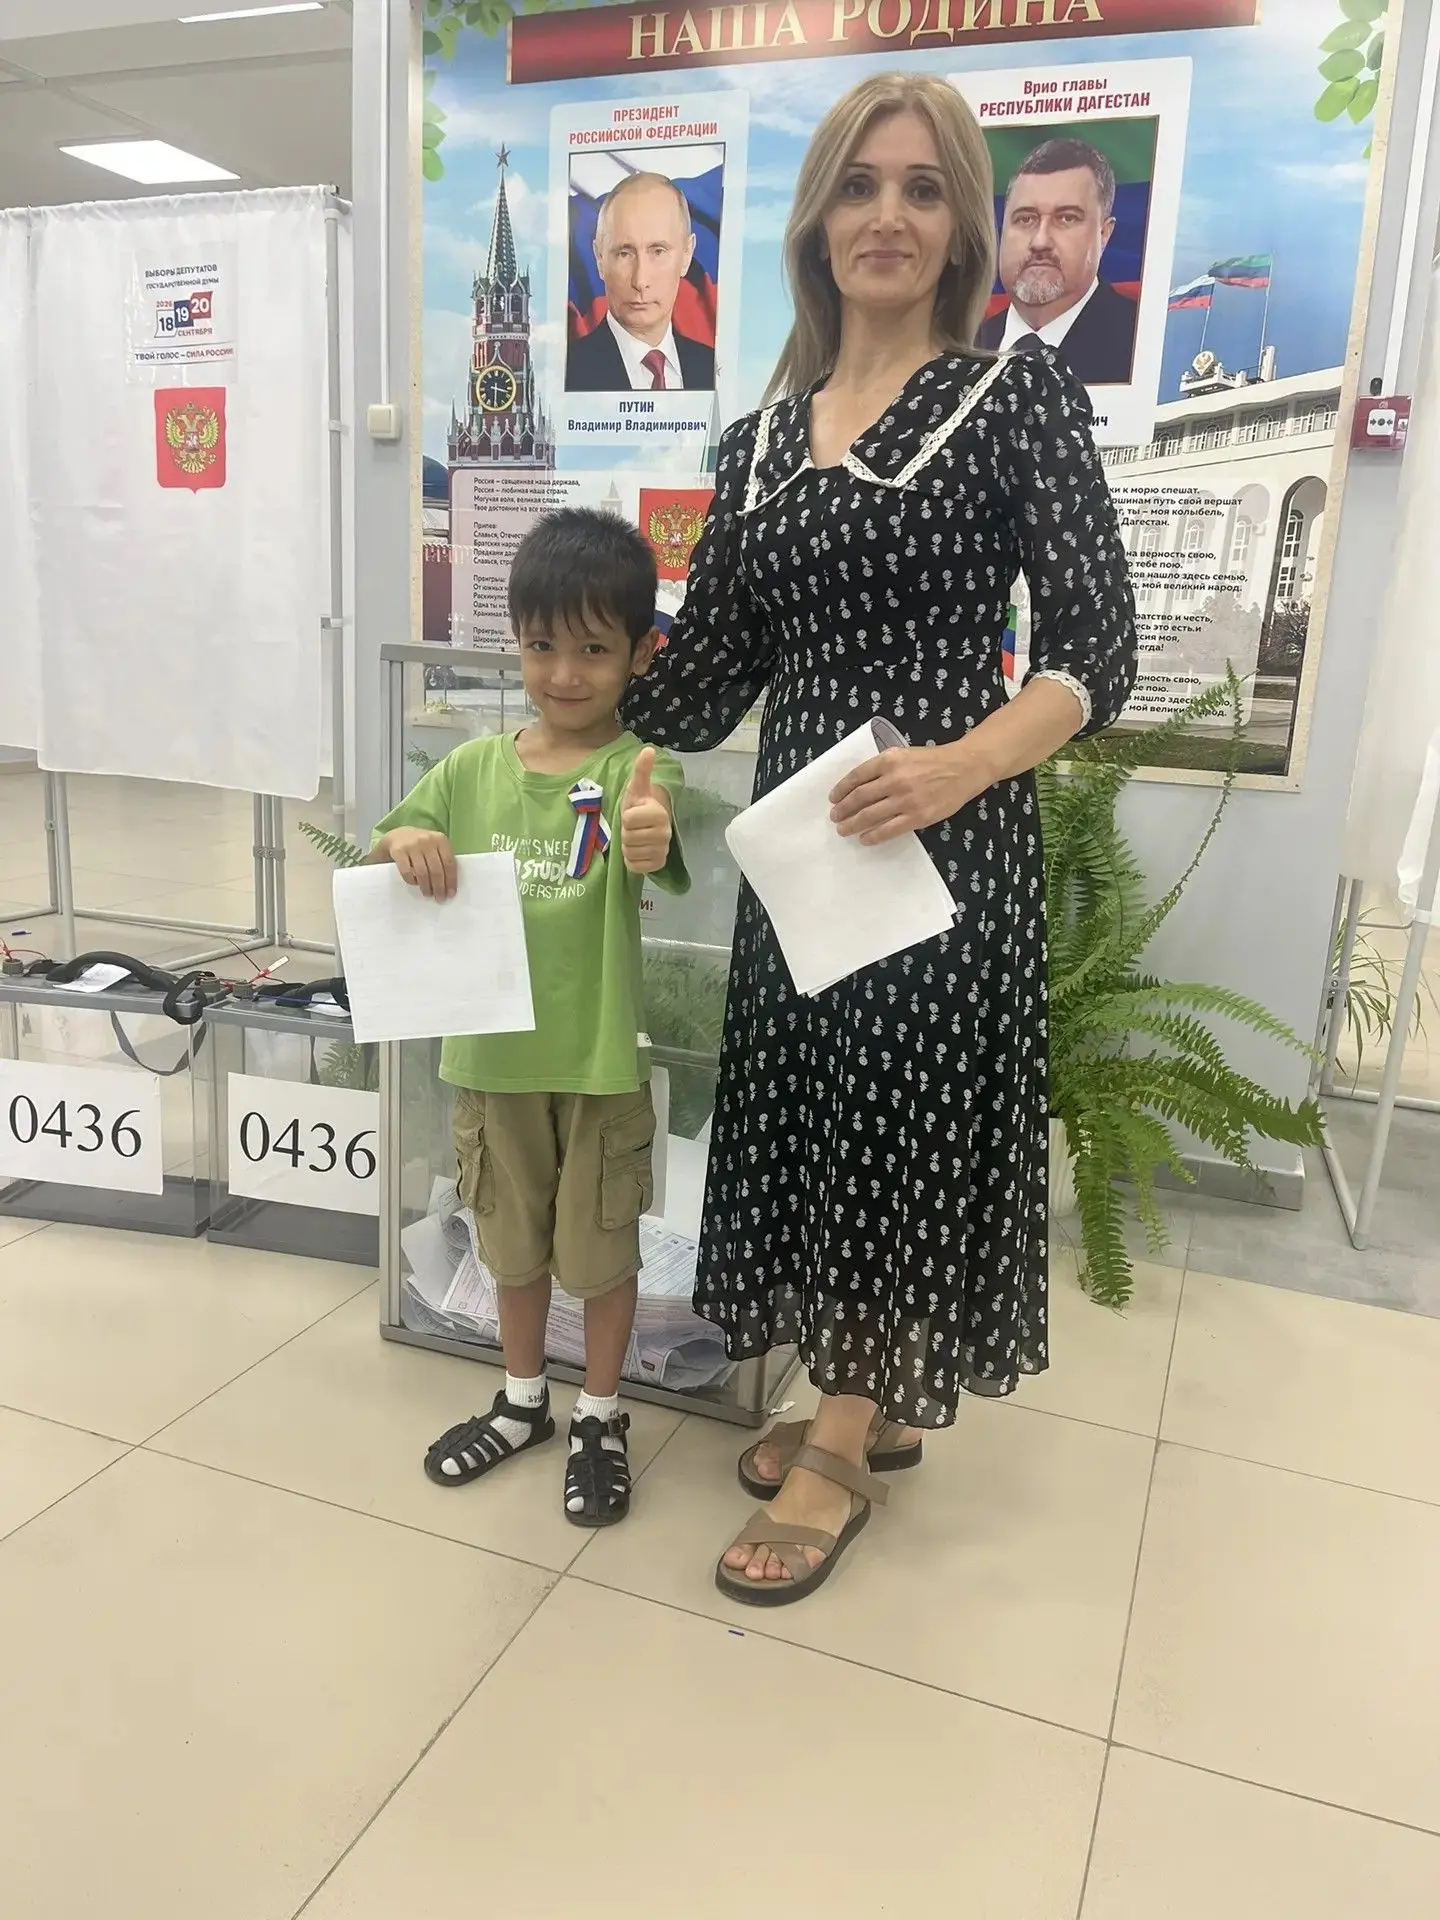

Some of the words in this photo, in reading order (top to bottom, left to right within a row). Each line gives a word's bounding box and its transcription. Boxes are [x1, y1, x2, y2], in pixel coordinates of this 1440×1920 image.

[627, 0, 807, 60] НАША
[1023, 80, 1058, 97] Врио
[1063, 78, 1107, 92] главы
[979, 98, 1073, 118] РЕСПУБЛИКИ
[1077, 92, 1150, 113] ДАГЕСТАН
[613, 105, 680, 123] ПРЕЗИДЕНТ
[569, 124, 642, 145] РОССИЙСКОЙ
[646, 122, 718, 140] ФЕДЕРАЦИИ
[145, 268, 175, 278] ВЫБОРЫ
[176, 264, 217, 275] ДЕПУТАТОВ
[146, 279, 201, 289] ГОСУДАРСТВЕННОЙ
[159, 317, 174, 331] 18
[175, 307, 189, 322] 19
[191, 298, 209, 313] 20
[135, 352, 155, 360] ТВОЙ
[156, 351, 179, 359] ГОЛОС
[186, 350, 204, 358] СИЛА
[619, 401, 654, 413] ПУТИН
[568, 419, 621, 433] Владимир
[625, 419, 707, 433] Владимирович
[474, 477, 494, 485] Россия
[1131, 487, 1159, 495] морю
[1153, 498, 1176, 507] путь
[1178, 497, 1202, 505] свой
[1204, 499, 1243, 507] вершат
[1171, 508, 1225, 517] колыбель,
[1121, 518, 1170, 526] Дагестан.
[1140, 551, 1186, 559] верность
[1187, 552, 1217, 560] свою,
[1136, 560, 1157, 568] тебе
[1182, 572, 1211, 580] здесь
[1212, 573, 1248, 582] семью,
[1142, 581, 1162, 589] мой
[1164, 582, 1206, 590] великий
[1207, 584, 1242, 593] народ.
[1135, 613, 1173, 621] ратство
[1158, 635, 1180, 643] моя,
[1136, 675, 1171, 683] рность
[1173, 676, 1202, 685] свою,
[1134, 695, 1166, 703] нашло
[1129, 703, 1148, 712] мой
[544, 838, 569, 857] NEE
[519, 882, 586, 899] DERSTAND
[9, 1094, 142, 1158] 0436
[240, 1111, 377, 1179] 0436
